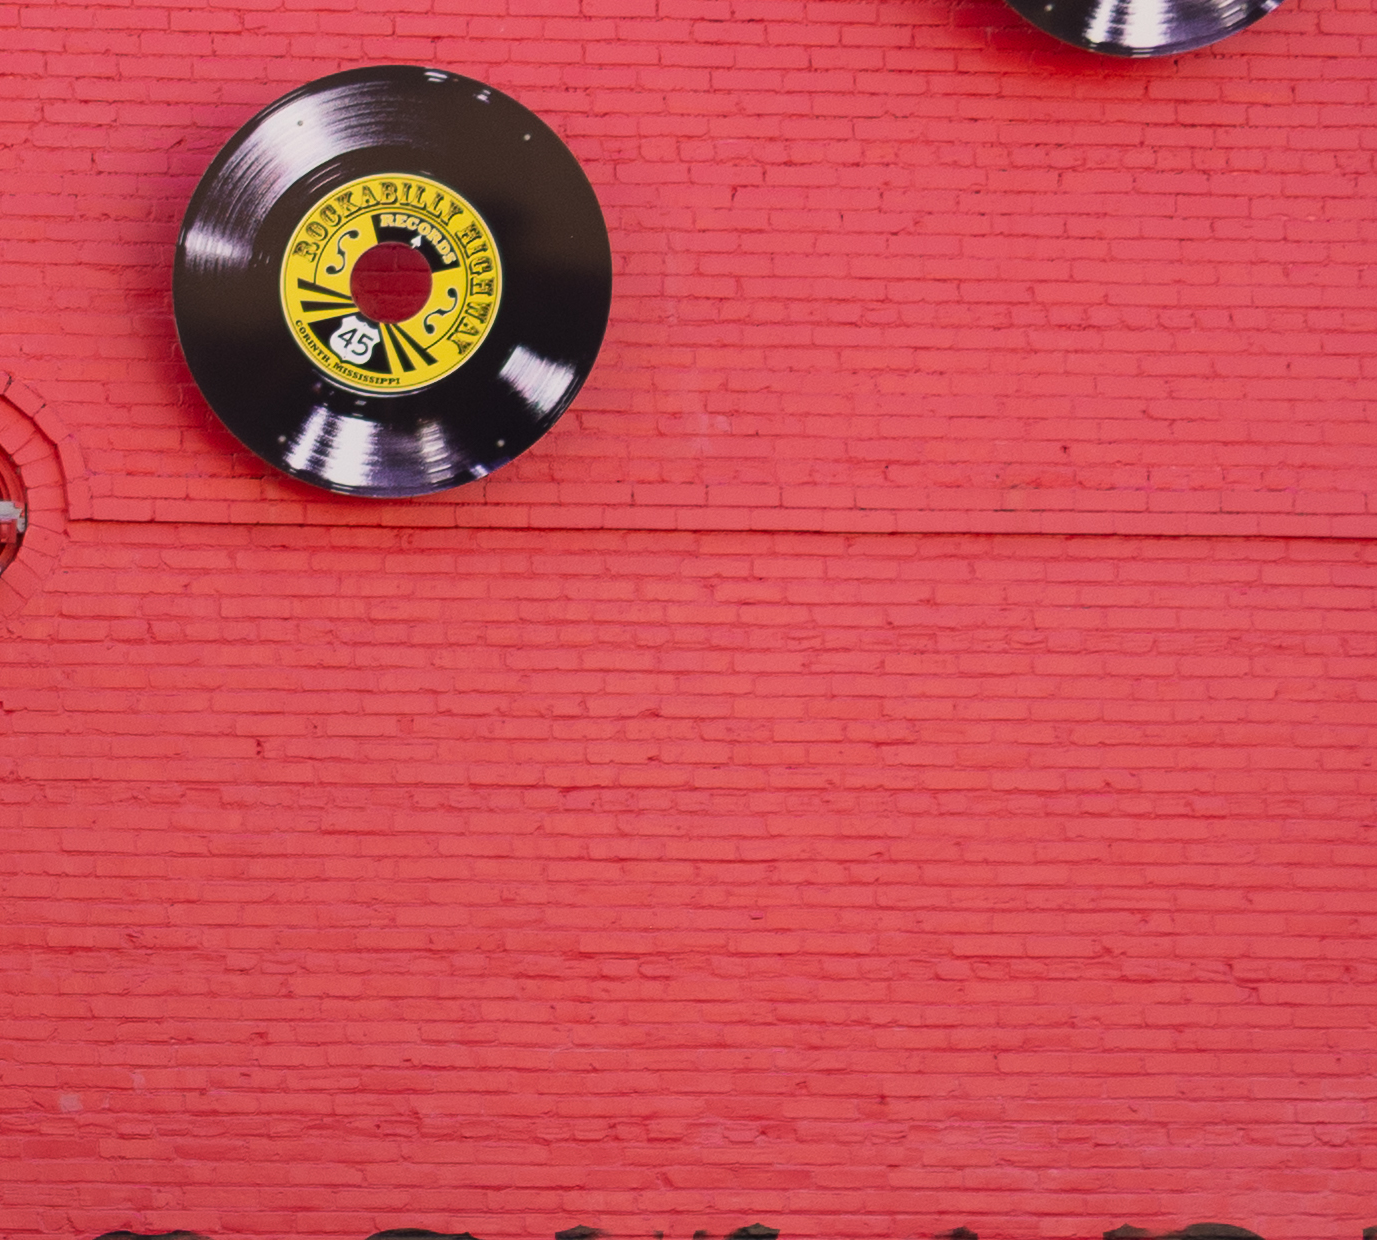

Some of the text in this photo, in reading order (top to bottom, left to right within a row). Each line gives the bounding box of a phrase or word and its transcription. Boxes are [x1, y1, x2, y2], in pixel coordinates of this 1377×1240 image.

[380, 214, 457, 264] RECORDS
[292, 181, 495, 356] ROCKABILLY HIGHWAY
[338, 328, 374, 357] 45
[333, 361, 401, 385] MISSISSIPPI
